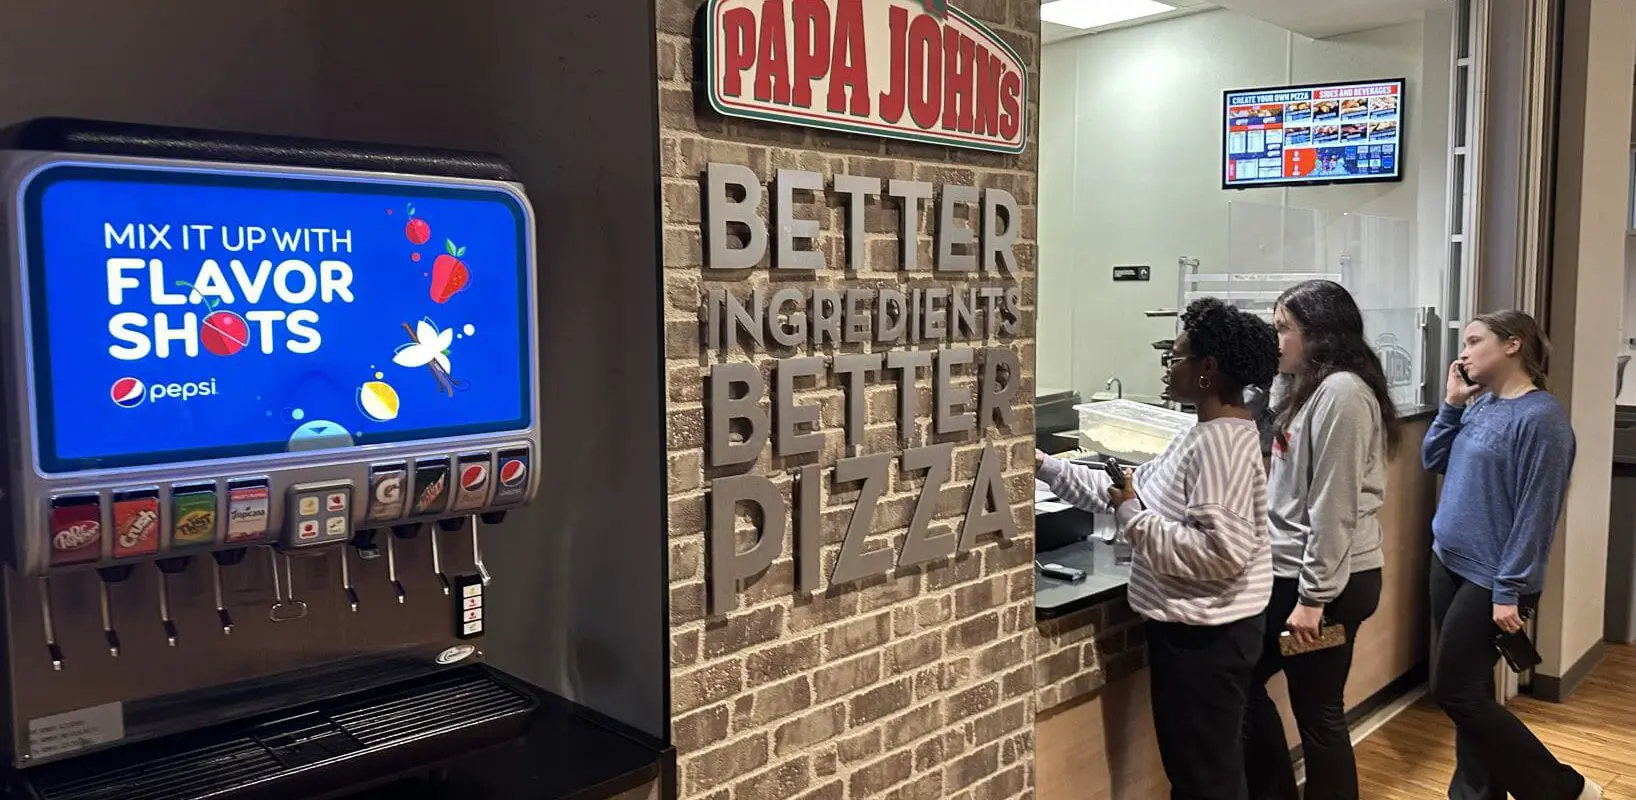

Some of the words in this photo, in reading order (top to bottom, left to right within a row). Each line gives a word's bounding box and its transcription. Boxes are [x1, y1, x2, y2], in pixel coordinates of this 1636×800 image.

[722, 0, 870, 117] PAPA
[879, 4, 1021, 140] JOHN'S
[1319, 90, 1338, 98] SIDES
[1340, 88, 1353, 96] AND
[1354, 86, 1392, 95] BEVERAGES
[1232, 96, 1256, 104] CREATE
[1257, 95, 1273, 103] YOUR
[1275, 94, 1290, 102] OWN
[1291, 92, 1309, 100] PIZZA
[104, 223, 171, 251] MIX
[182, 225, 213, 251] IT
[222, 226, 266, 251] UP
[272, 228, 352, 253] WITH
[707, 162, 1021, 271] BETTER
[106, 258, 354, 306] FLAVOR
[108, 310, 322, 361] SHOTS
[707, 287, 1022, 348] INGREDIENTS
[149, 377, 218, 403] pepsi
[710, 349, 1022, 467] BETTER
[712, 440, 1018, 617] PIZZA
